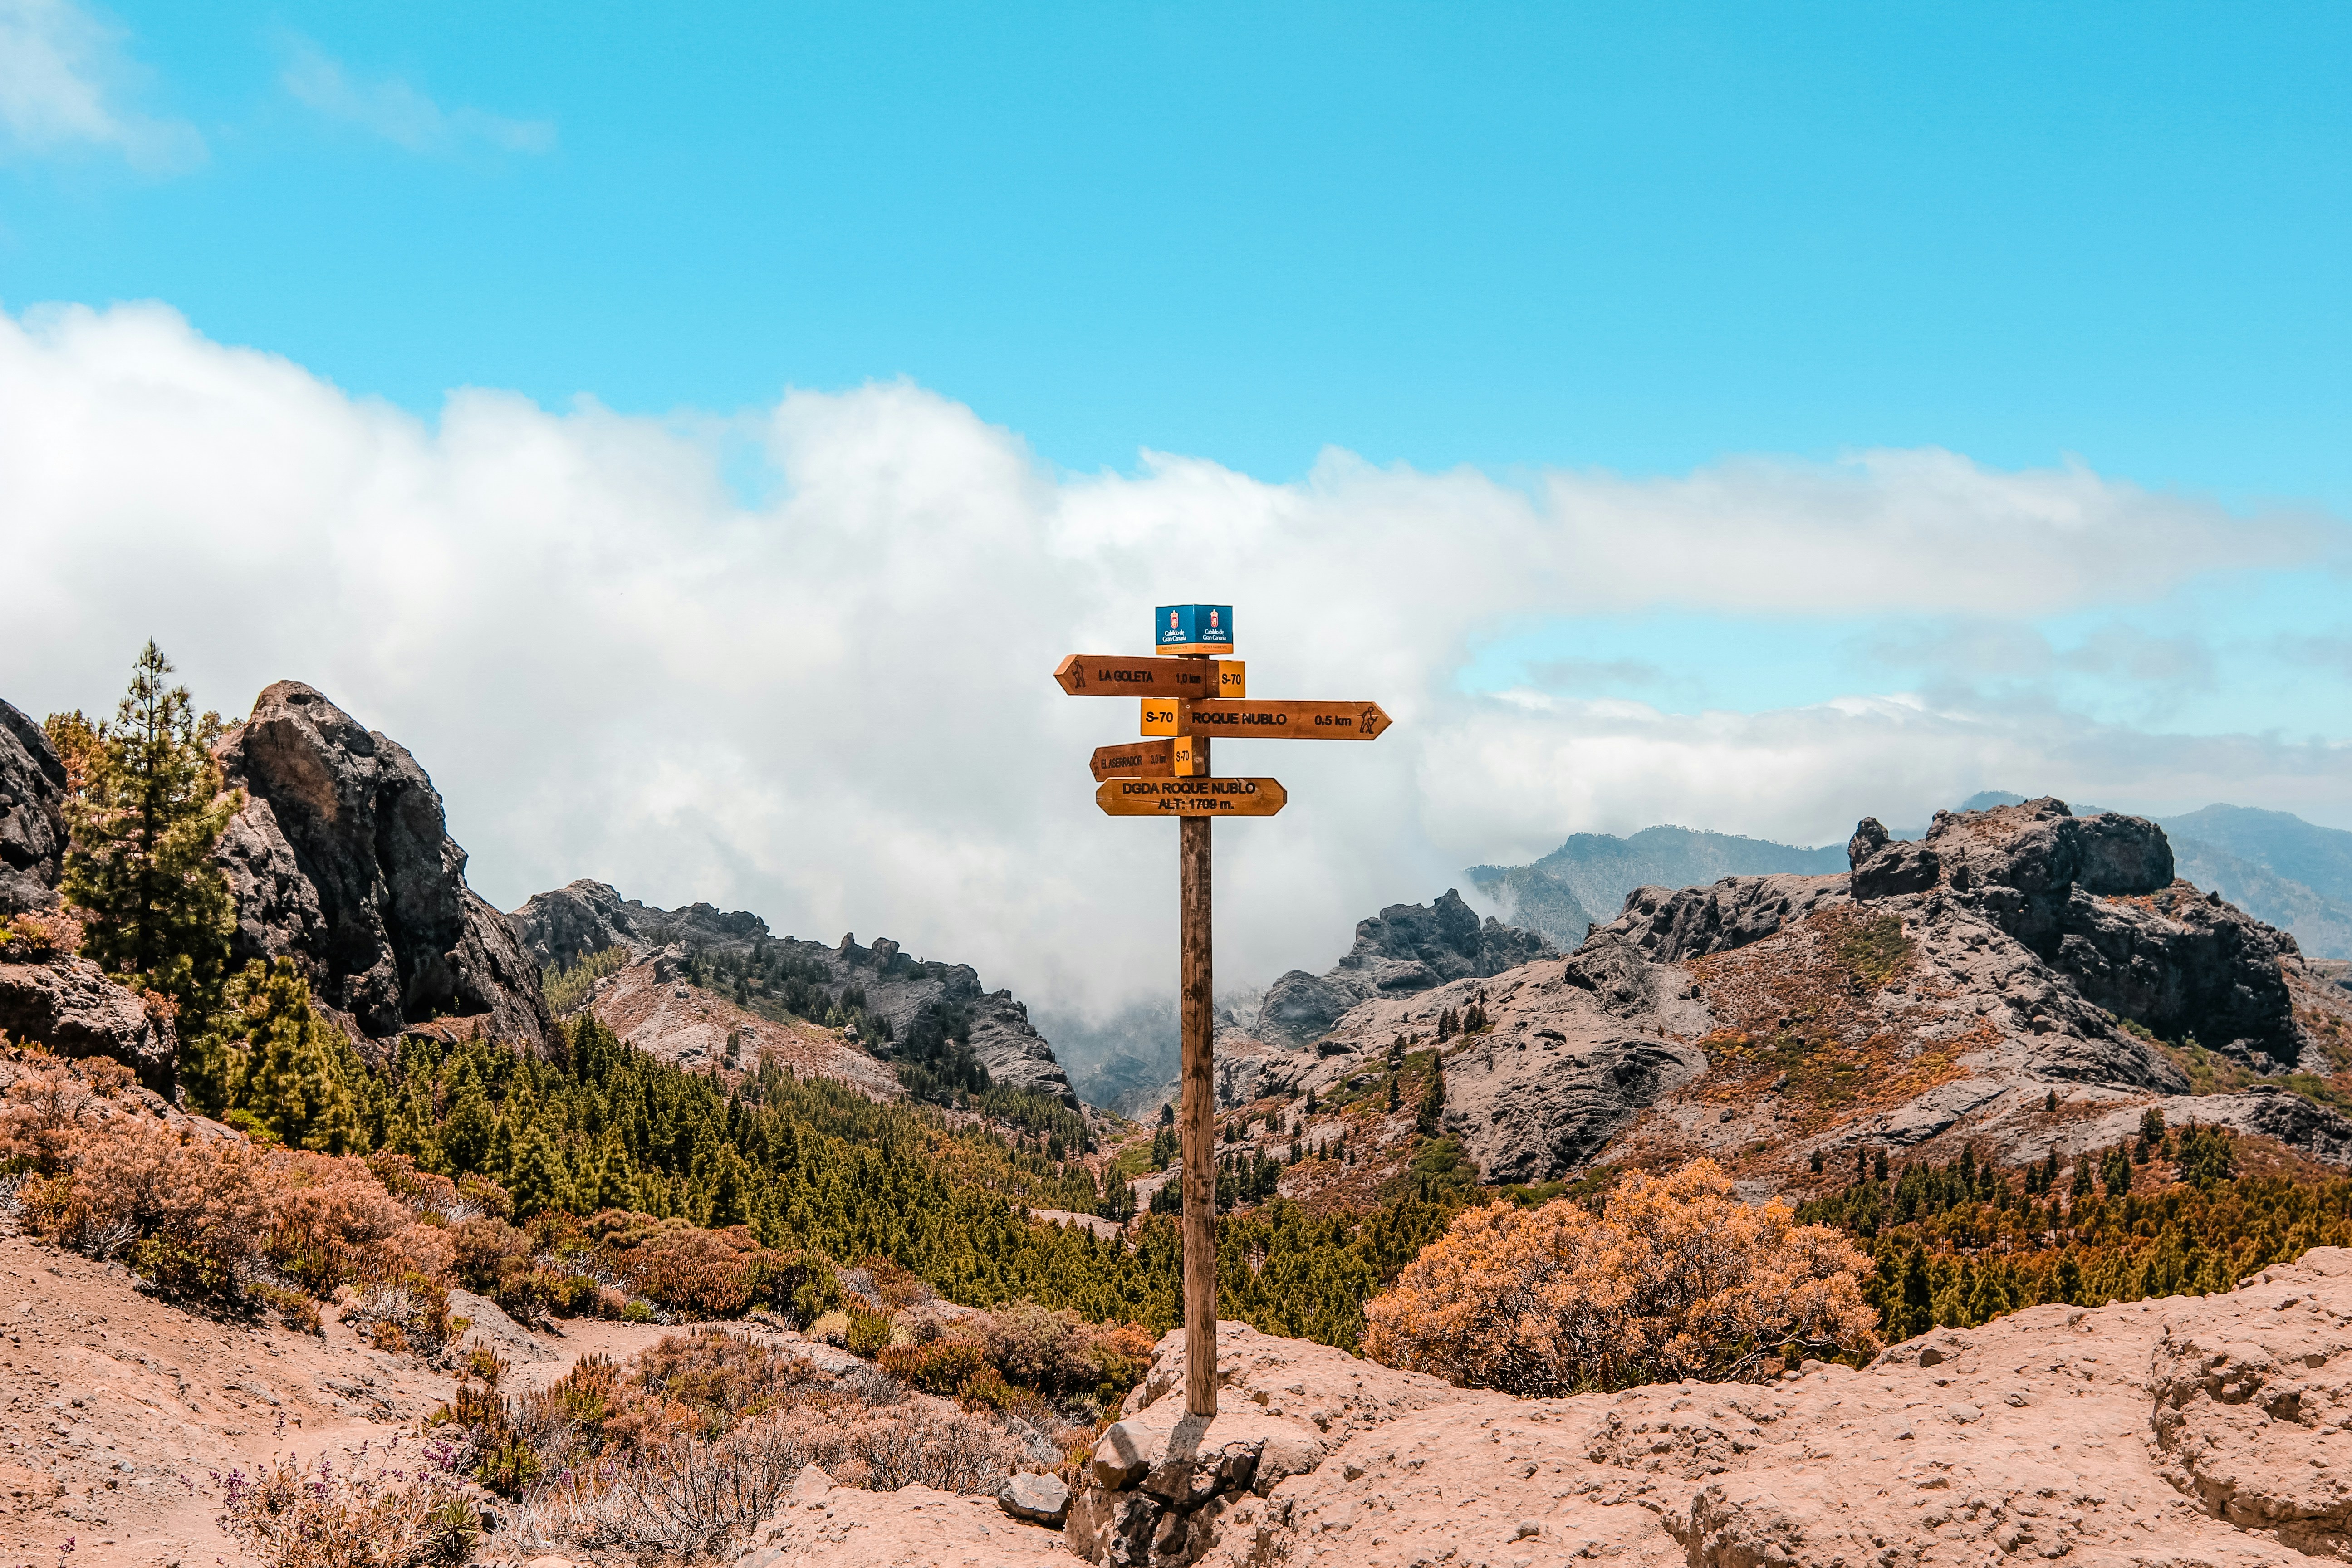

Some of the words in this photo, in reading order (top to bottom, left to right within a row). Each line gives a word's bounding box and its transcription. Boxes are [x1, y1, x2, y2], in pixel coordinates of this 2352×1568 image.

[1099, 669, 1112, 682] LA
[1113, 670, 1154, 683] GOLETA
[1176, 673, 1188, 685] 1,0
[1189, 674, 1201, 684] km
[1221, 674, 1241, 685] S-70
[1146, 711, 1174, 723] S-70
[1192, 712, 1239, 725] ROQUE
[1242, 713, 1287, 725] NUBLO
[1334, 715, 1351, 726] km
[1101, 759, 1107, 769] EL
[1108, 755, 1142, 769] ASERRADOR
[1159, 754, 1167, 764] km
[1176, 750, 1189, 762] S-70
[1123, 783, 1160, 794] DGDA
[1162, 783, 1209, 794] ROQUE
[1211, 783, 1256, 794] NUBLO
[1158, 798, 1185, 809] ALT:
[1189, 799, 1217, 809] 1709
[1220, 800, 1234, 809] m.
